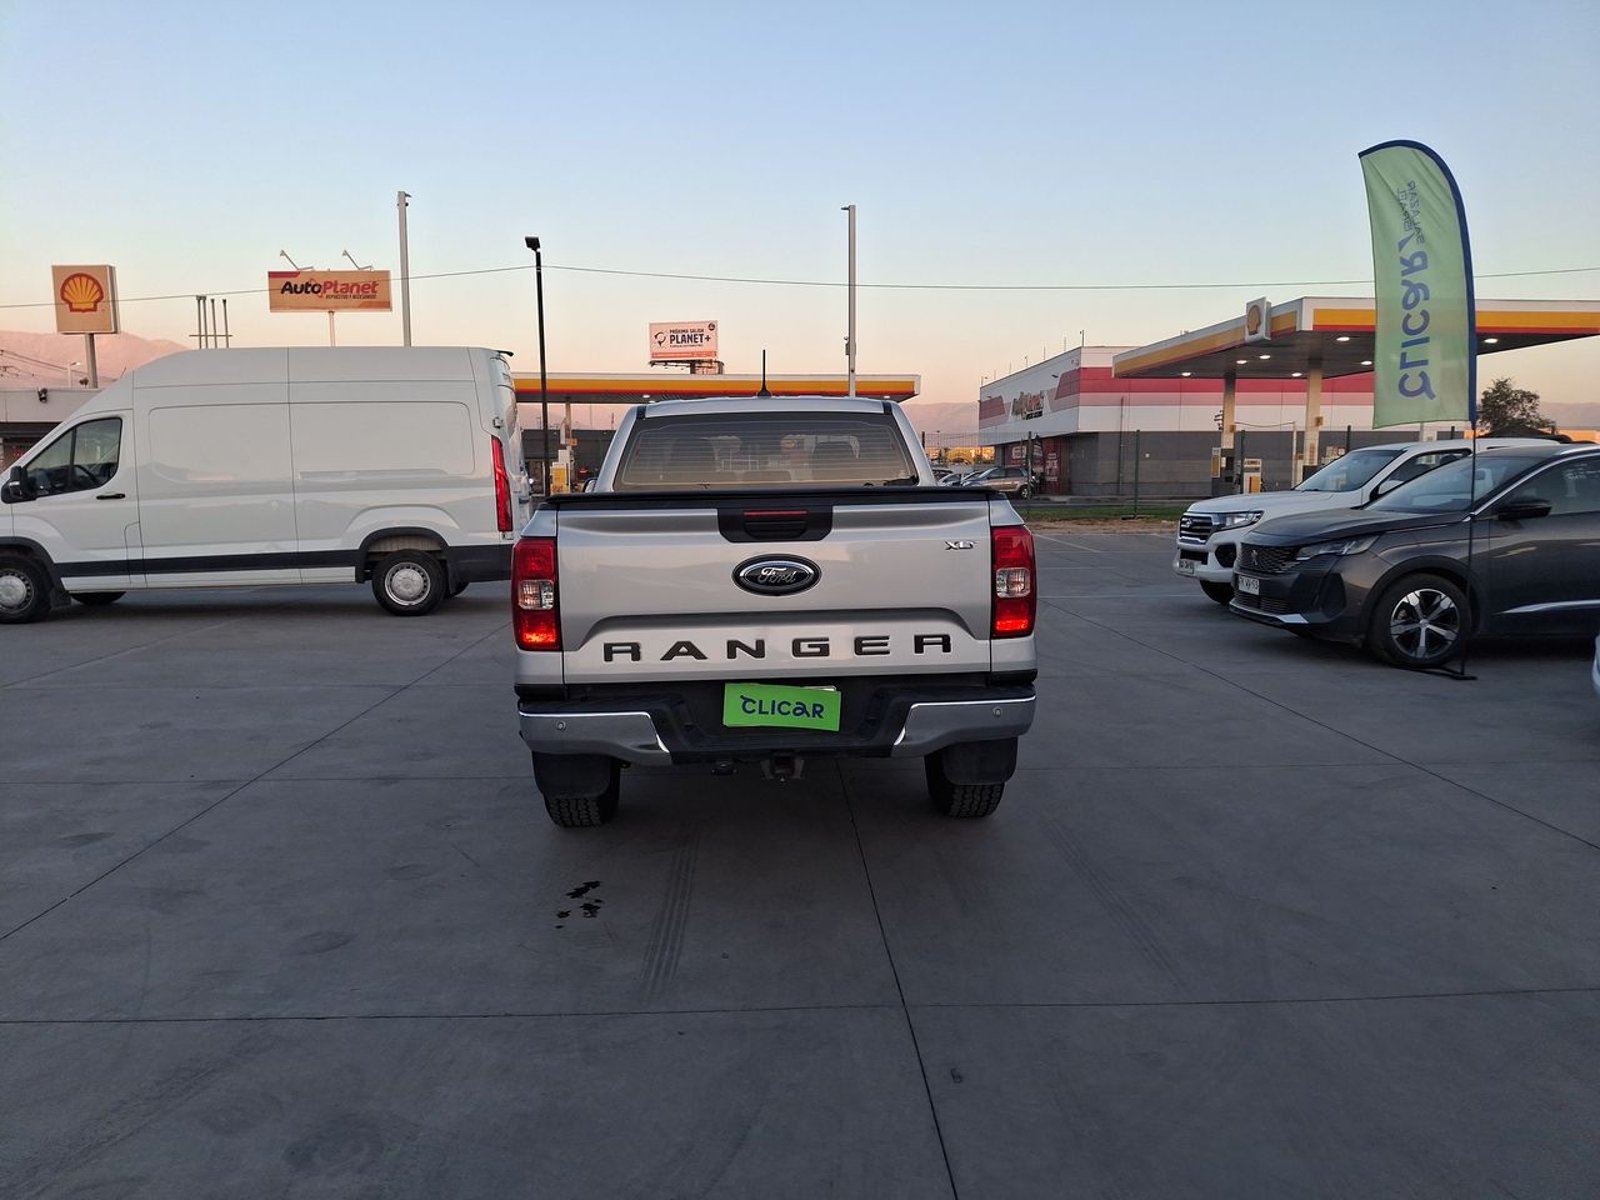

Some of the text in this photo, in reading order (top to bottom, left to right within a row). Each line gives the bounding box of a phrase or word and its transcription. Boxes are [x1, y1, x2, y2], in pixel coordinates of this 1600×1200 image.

[281, 280, 379, 295] AutoPlanet
[758, 566, 797, 584] Ford
[603, 633, 952, 662] RANGER
